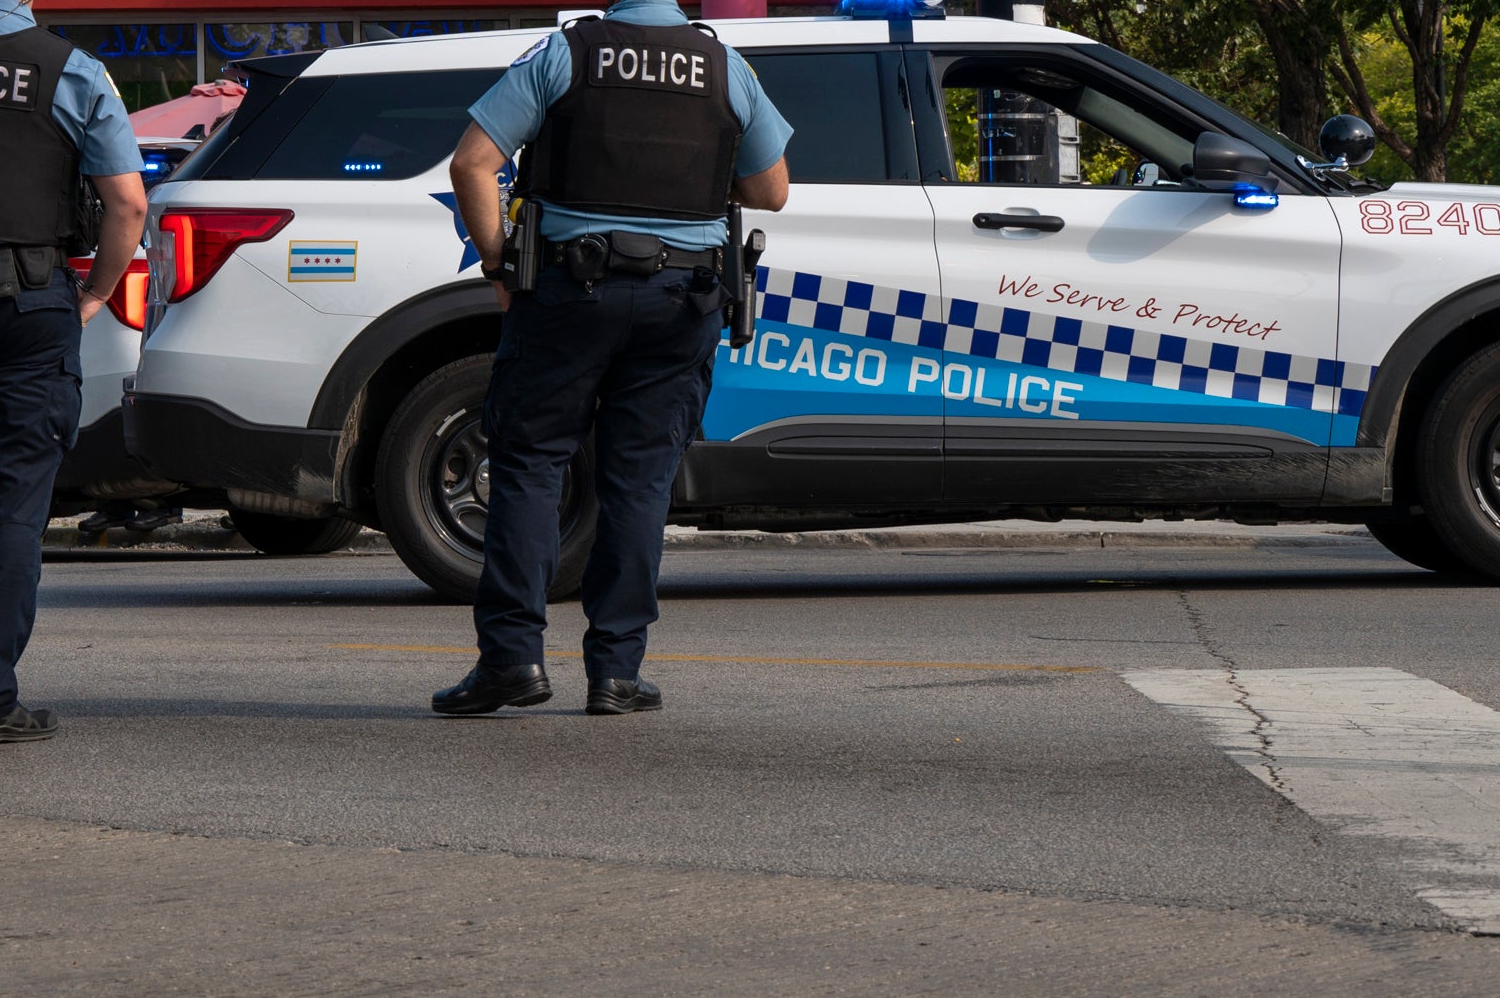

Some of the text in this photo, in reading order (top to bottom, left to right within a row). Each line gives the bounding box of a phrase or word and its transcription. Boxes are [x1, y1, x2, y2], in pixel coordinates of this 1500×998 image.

[597, 46, 705, 89] POLICE
[1358, 199, 1500, 236] 8240
[998, 274, 1282, 341] We Serve & Protect
[715, 328, 1084, 420] HICAGO POLICE
